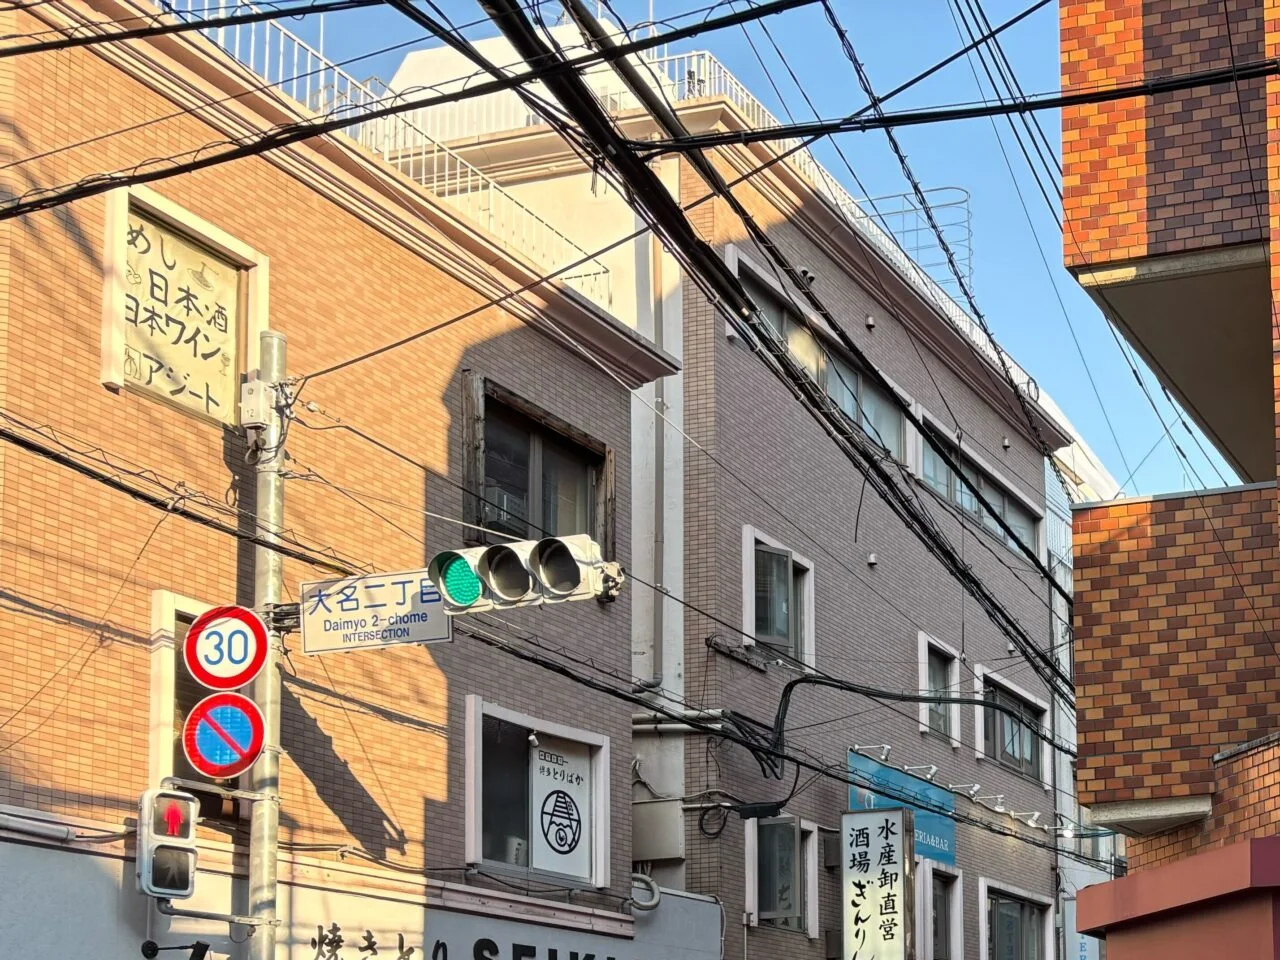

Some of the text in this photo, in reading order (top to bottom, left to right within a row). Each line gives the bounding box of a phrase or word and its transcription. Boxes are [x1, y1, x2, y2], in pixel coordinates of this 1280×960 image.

[127, 224, 176, 270] めし
[149, 268, 228, 333] 日本酒
[126, 293, 221, 360] 日本ワイン
[143, 353, 220, 413] アジート
[309, 578, 442, 615] 大名二丁目
[324, 612, 428, 632] Daimyo 2-chome
[342, 627, 410, 643] INTERSECTION
[204, 629, 249, 666] 30
[877, 818, 899, 941] 水産卸直営
